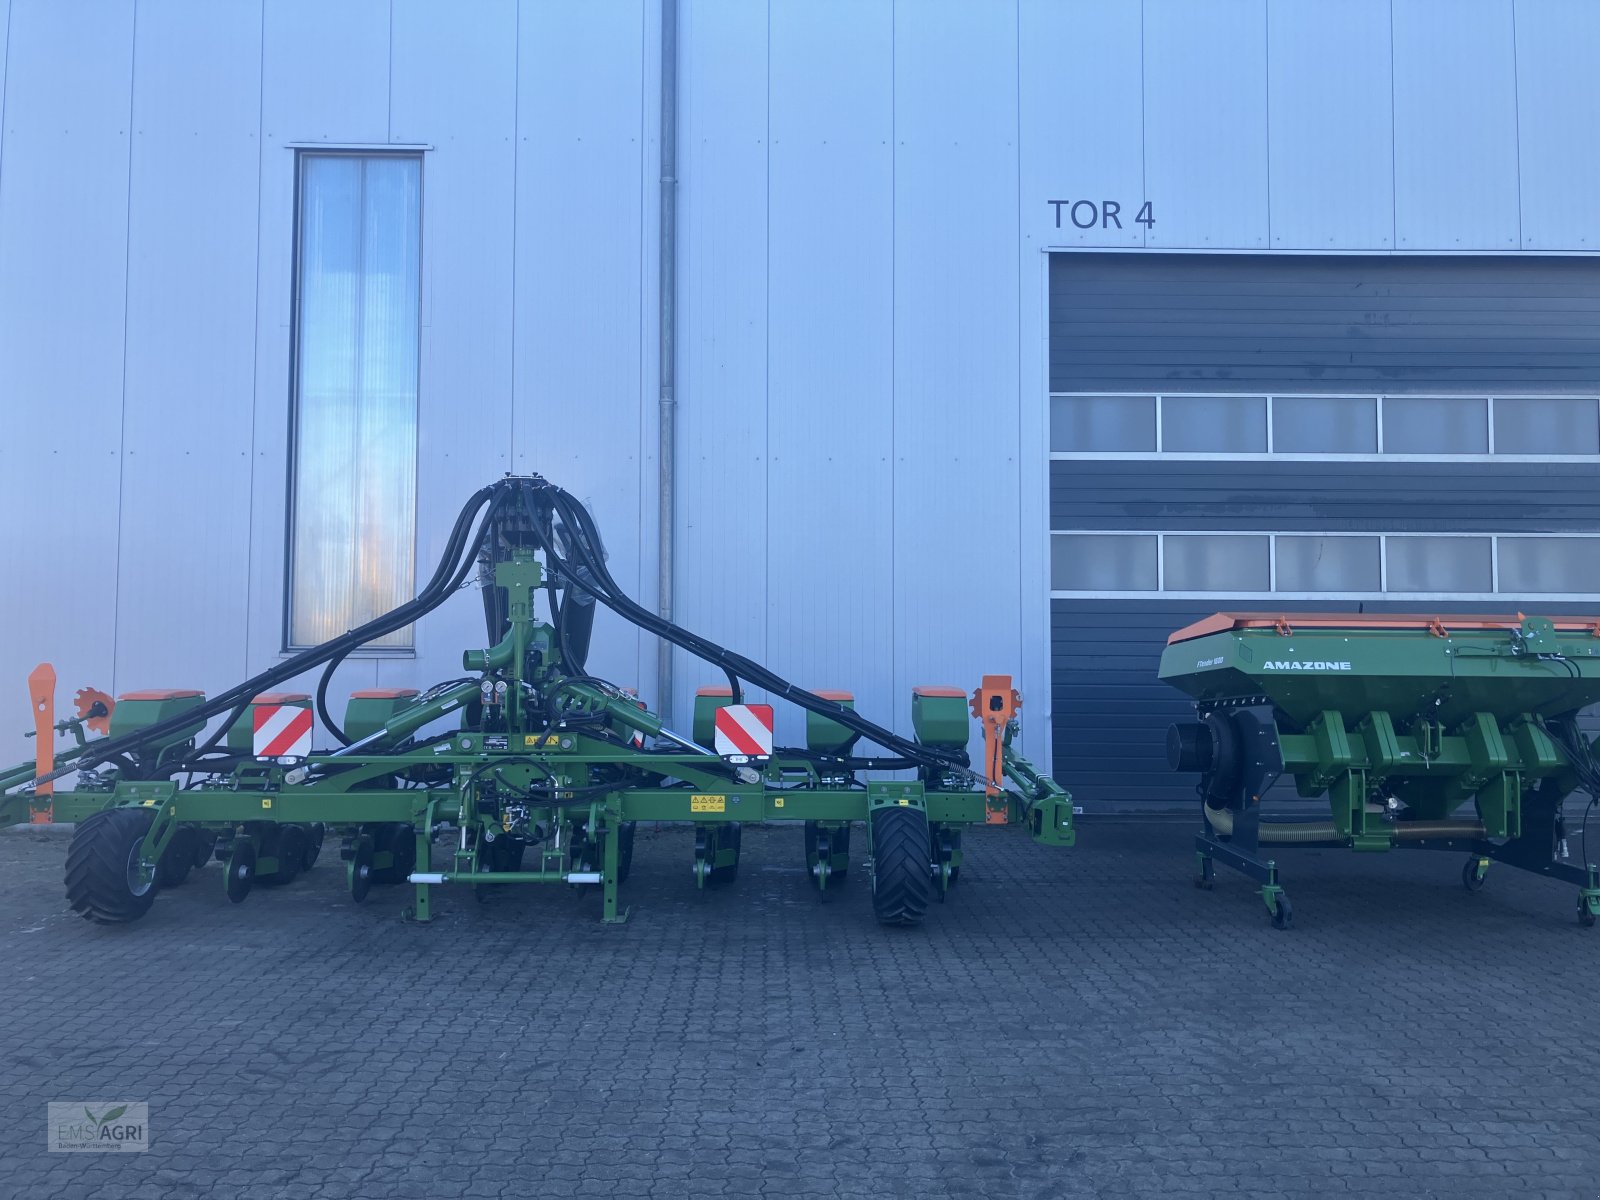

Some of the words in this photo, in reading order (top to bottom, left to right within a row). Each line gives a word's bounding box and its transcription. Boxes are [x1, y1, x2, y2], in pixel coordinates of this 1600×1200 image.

[1047, 200, 1122, 229] TOR
[1134, 201, 1156, 229] 4
[1263, 661, 1351, 670] AMAZONE
